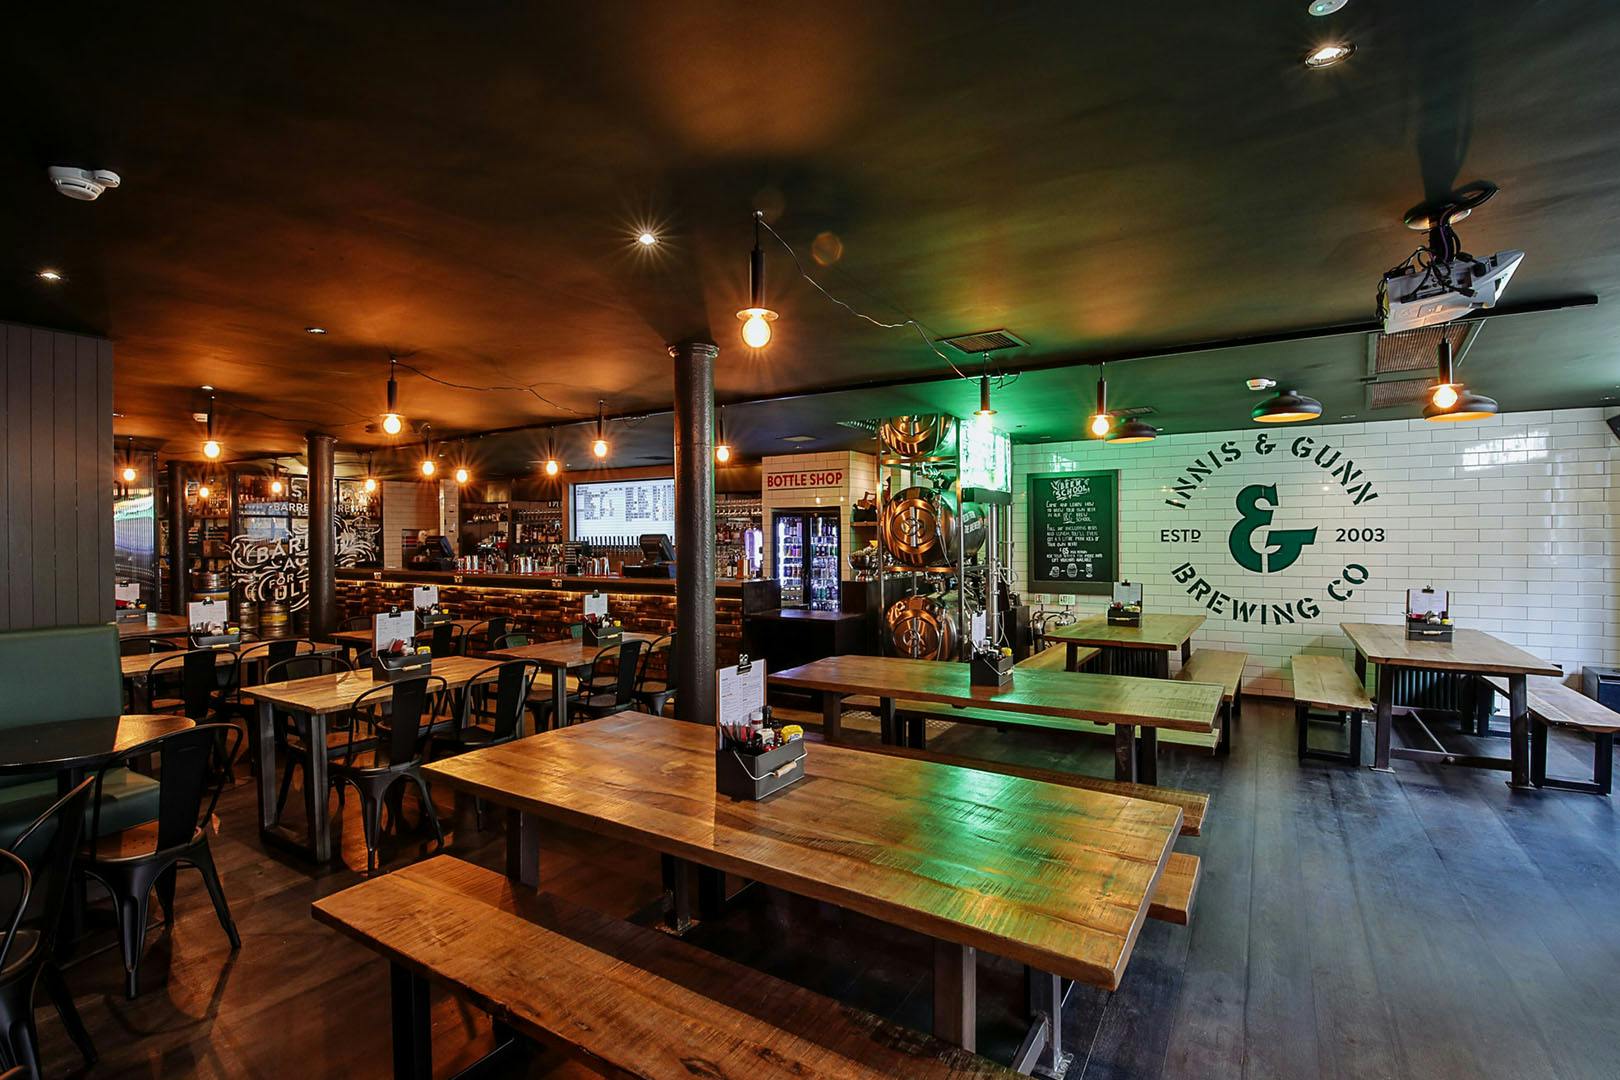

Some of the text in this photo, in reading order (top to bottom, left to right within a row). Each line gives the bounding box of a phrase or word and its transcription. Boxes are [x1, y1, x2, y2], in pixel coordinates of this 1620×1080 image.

[1165, 433, 1379, 509] INNIS & GUNN
[767, 471, 843, 488] BOTTLE SHOP
[1055, 485, 1088, 499] SCHOOL
[273, 502, 309, 512] BARRE
[1336, 528, 1385, 542] 2003
[269, 574, 294, 589] FOR
[1171, 561, 1369, 625] BREWING CO
